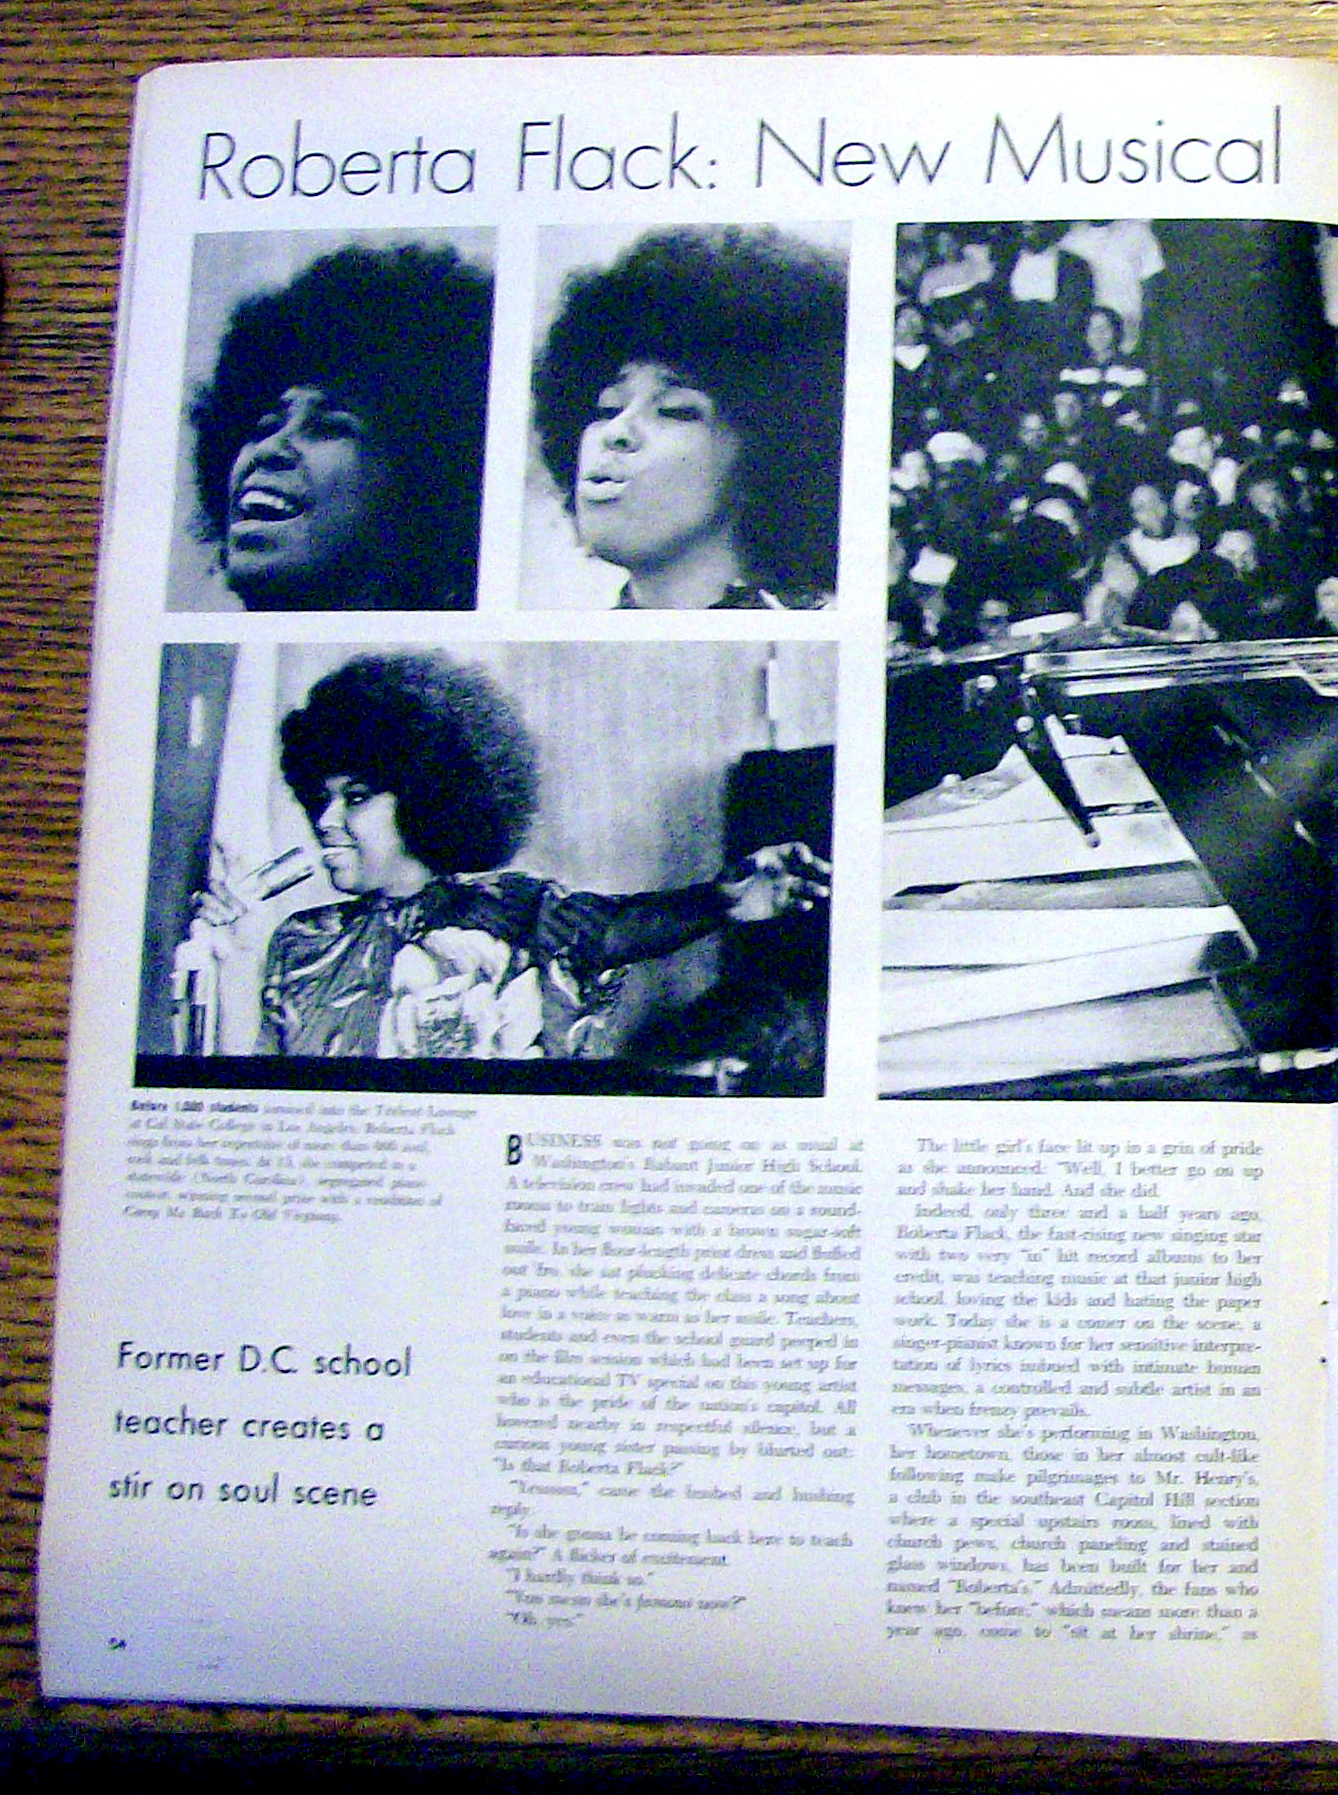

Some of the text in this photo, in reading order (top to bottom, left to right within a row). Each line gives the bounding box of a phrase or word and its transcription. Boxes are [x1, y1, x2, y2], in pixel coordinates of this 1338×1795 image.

[200, 119, 475, 200] Roberta
[517, 111, 719, 193] Flack:
[755, 115, 951, 189] New
[985, 104, 1282, 185] Musical
[117, 1341, 225, 1372] Former
[314, 1343, 412, 1377] school
[113, 1404, 384, 1442] teacher creates a
[109, 1471, 378, 1507] stir on soul scene
